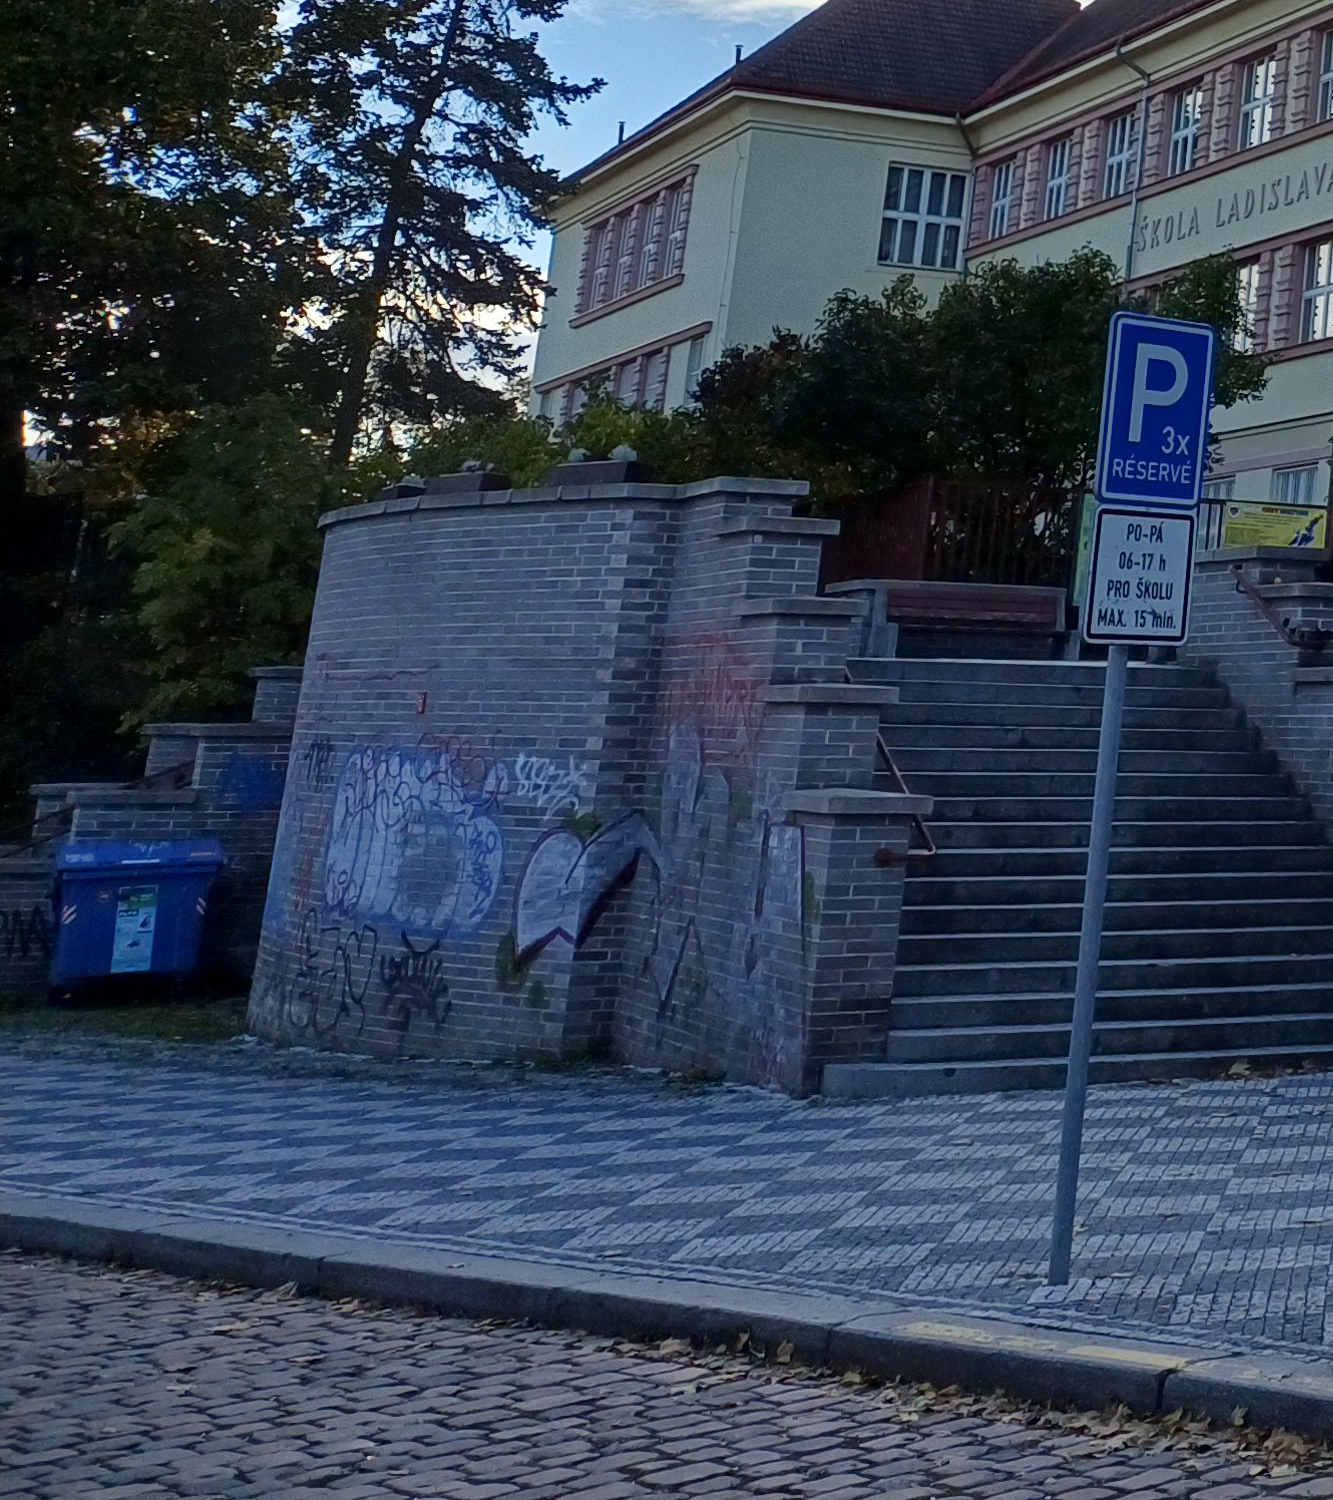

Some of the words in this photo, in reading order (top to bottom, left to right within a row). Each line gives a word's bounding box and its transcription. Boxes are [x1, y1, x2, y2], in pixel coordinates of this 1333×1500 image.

[1136, 205, 1200, 252] ŠKOLA
[1128, 342, 1189, 443] P
[1161, 425, 1190, 456] 3x
[1112, 453, 1192, 484] RÉSERVÉ
[1126, 521, 1164, 544] PO-PÁ
[1118, 551, 1154, 571] 06-17
[1158, 553, 1167, 572] h
[1106, 579, 1131, 598] PRO
[1135, 576, 1174, 601] ŠKOLU
[1097, 607, 1127, 627] MAX.
[1134, 609, 1147, 628] 15
